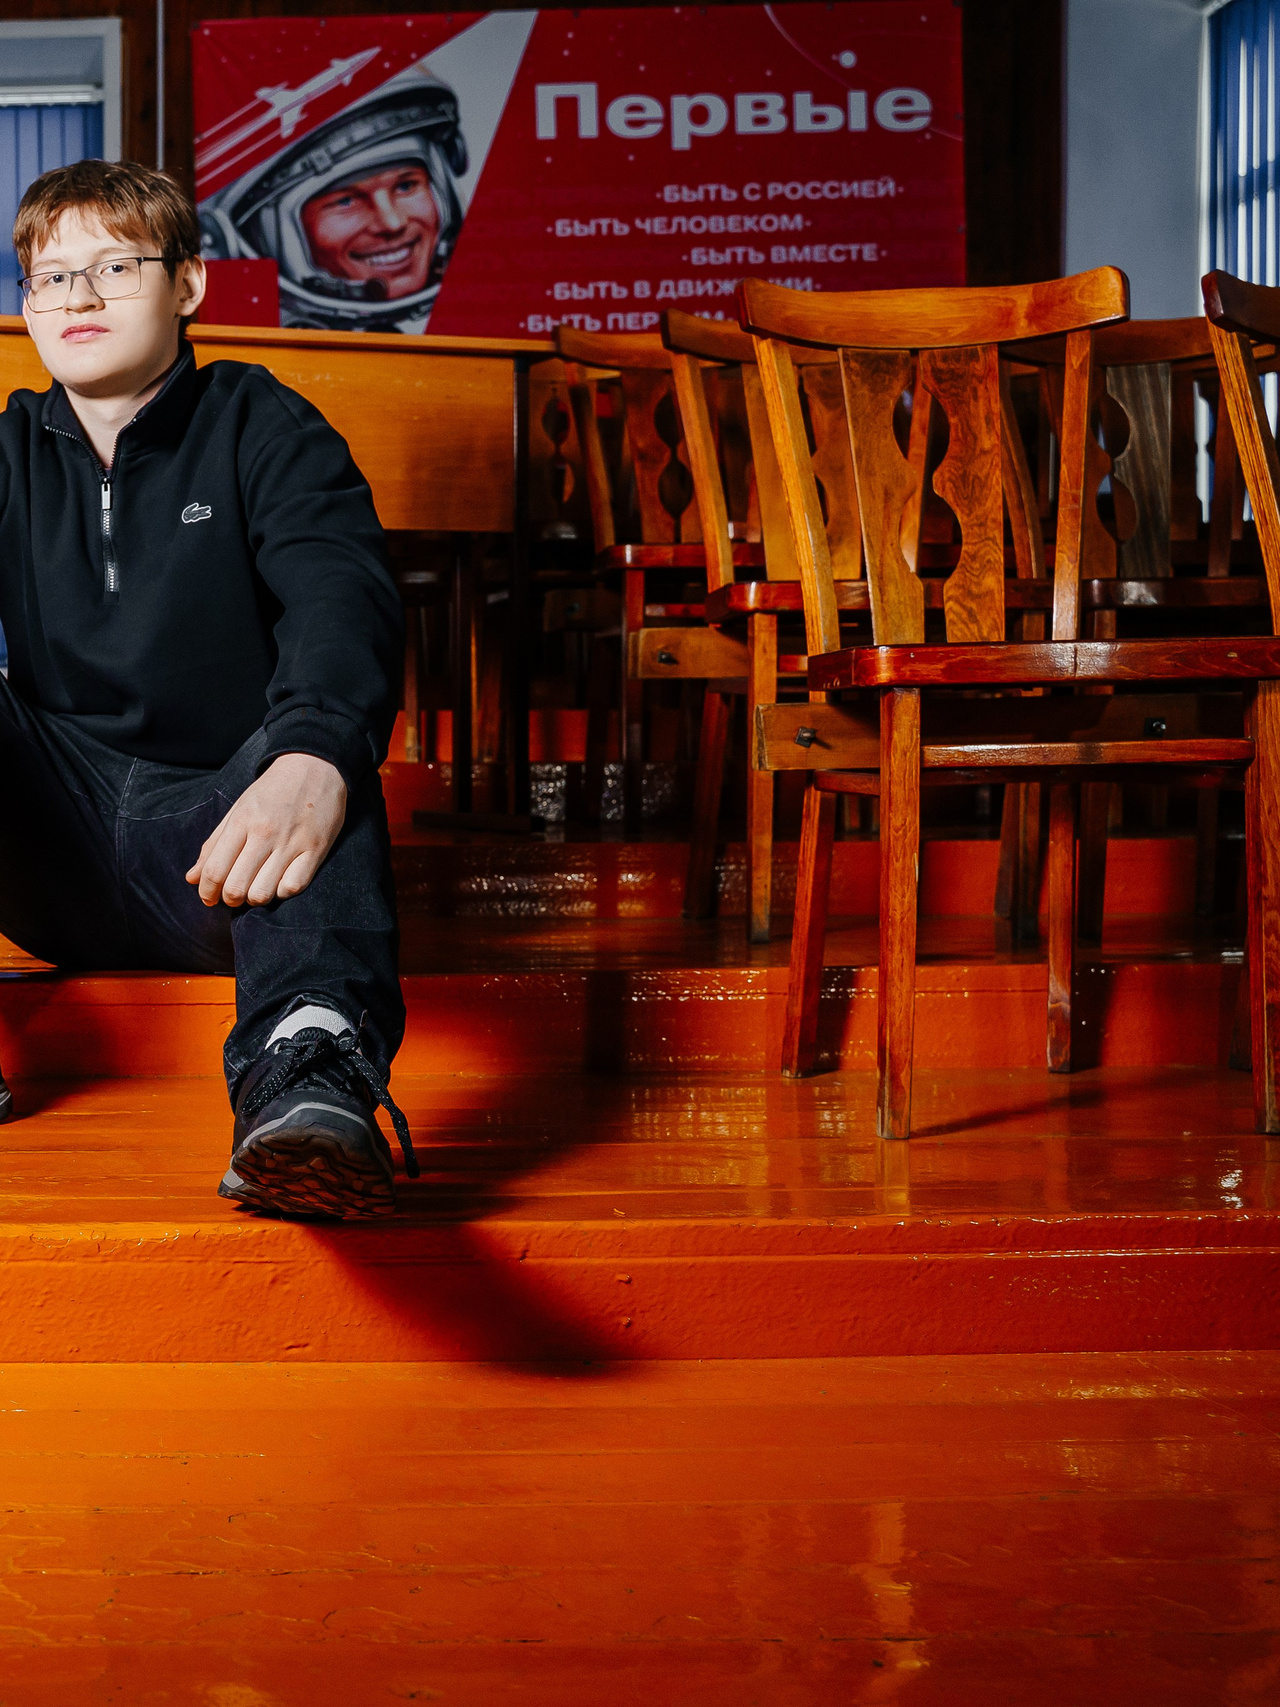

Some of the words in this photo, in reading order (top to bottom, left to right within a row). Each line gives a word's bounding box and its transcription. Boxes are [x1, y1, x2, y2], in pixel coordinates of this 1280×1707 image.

[535, 83, 932, 150] Первые
[743, 183, 761, 201] С
[633, 280, 650, 298] В
